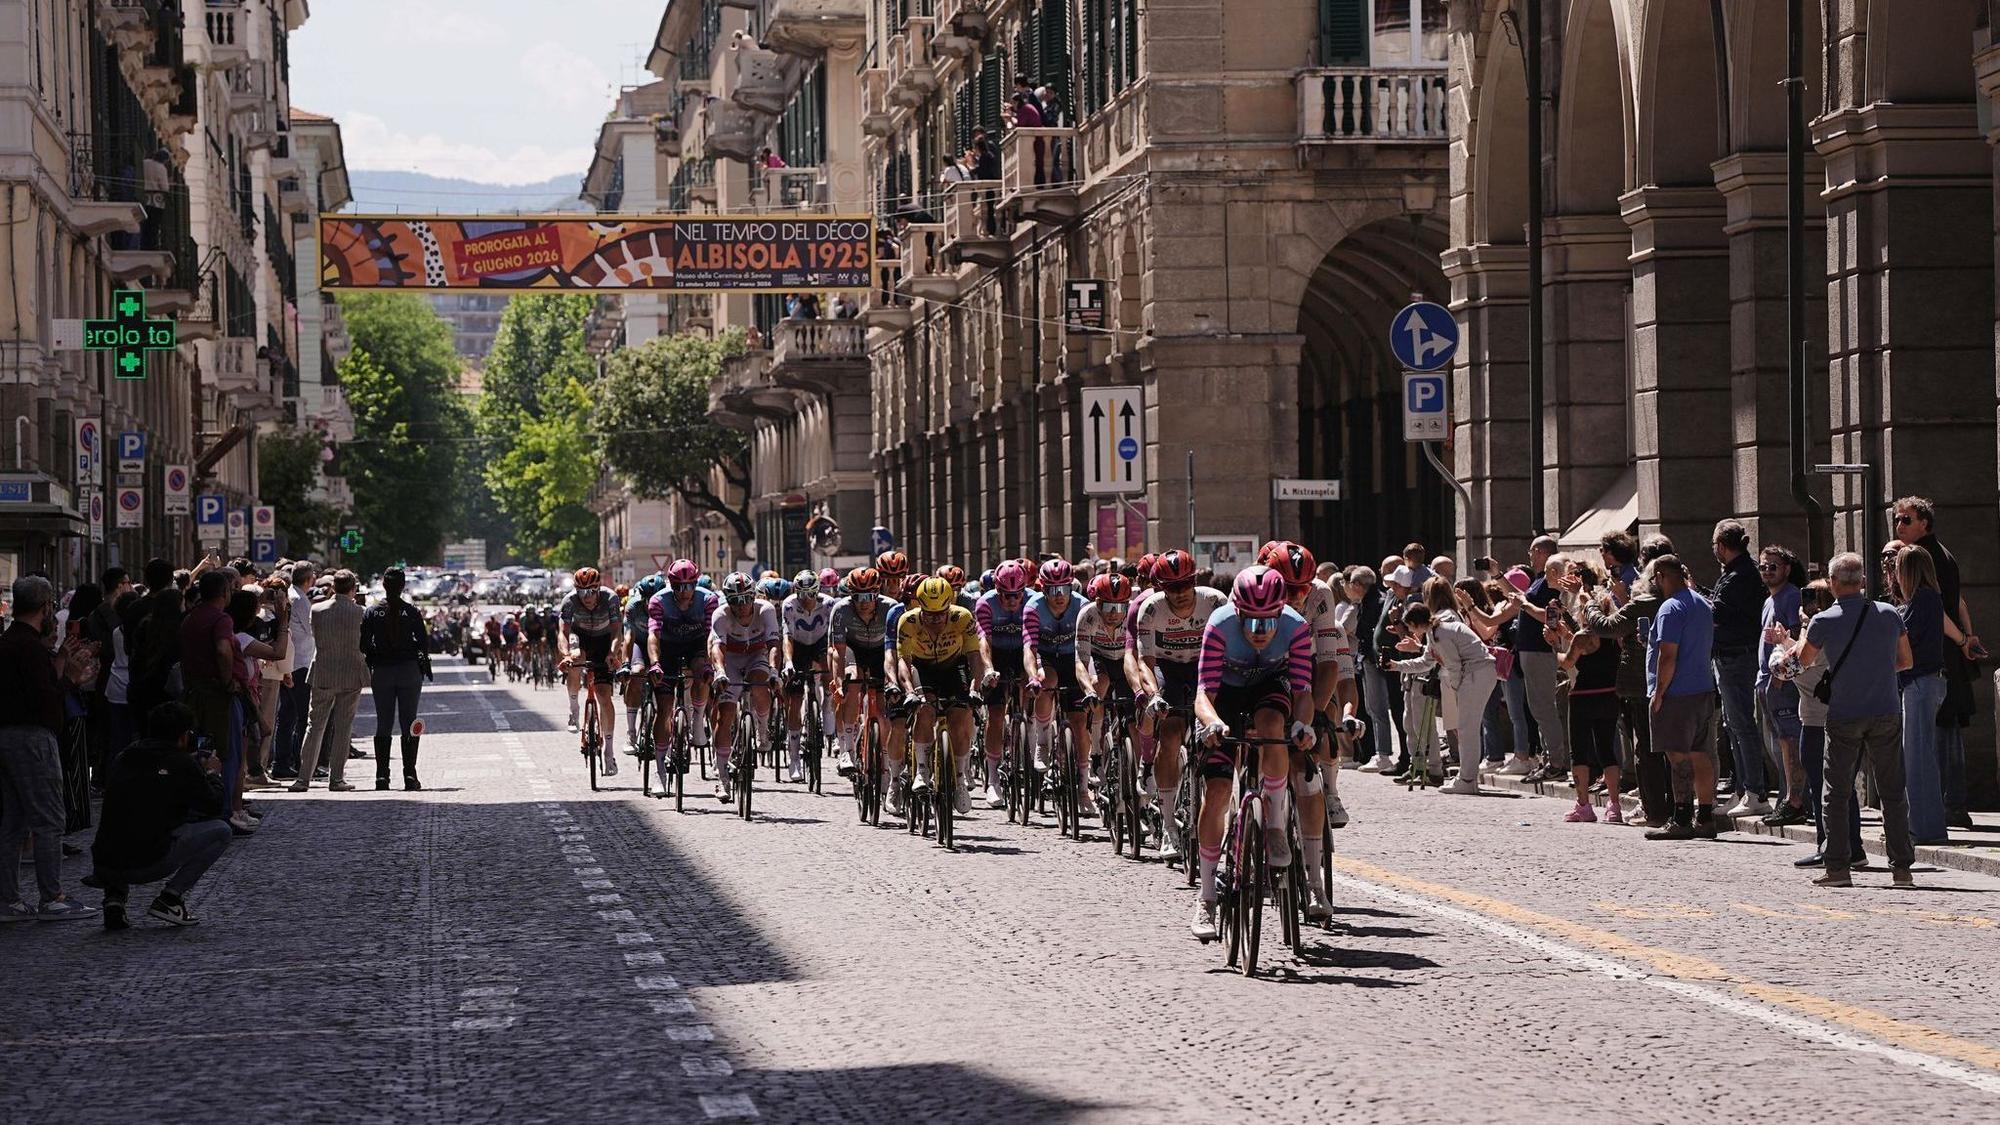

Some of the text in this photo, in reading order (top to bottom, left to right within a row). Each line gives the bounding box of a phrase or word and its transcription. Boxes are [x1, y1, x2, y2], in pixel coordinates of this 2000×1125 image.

[675, 220, 870, 241] NEL TEMPO DEL DÉCO
[464, 232, 549, 256] PROROGATA AL
[676, 243, 869, 269] ALBISOLA 1925
[461, 249, 559, 276] 7 GIUGNO 2026
[676, 272, 696, 280] Museo
[713, 271, 742, 279] Ceramica
[1072, 283, 1097, 308] T
[1415, 382, 1436, 408] P
[124, 436, 140, 456] P
[202, 498, 219, 522] P
[258, 541, 271, 560] P
